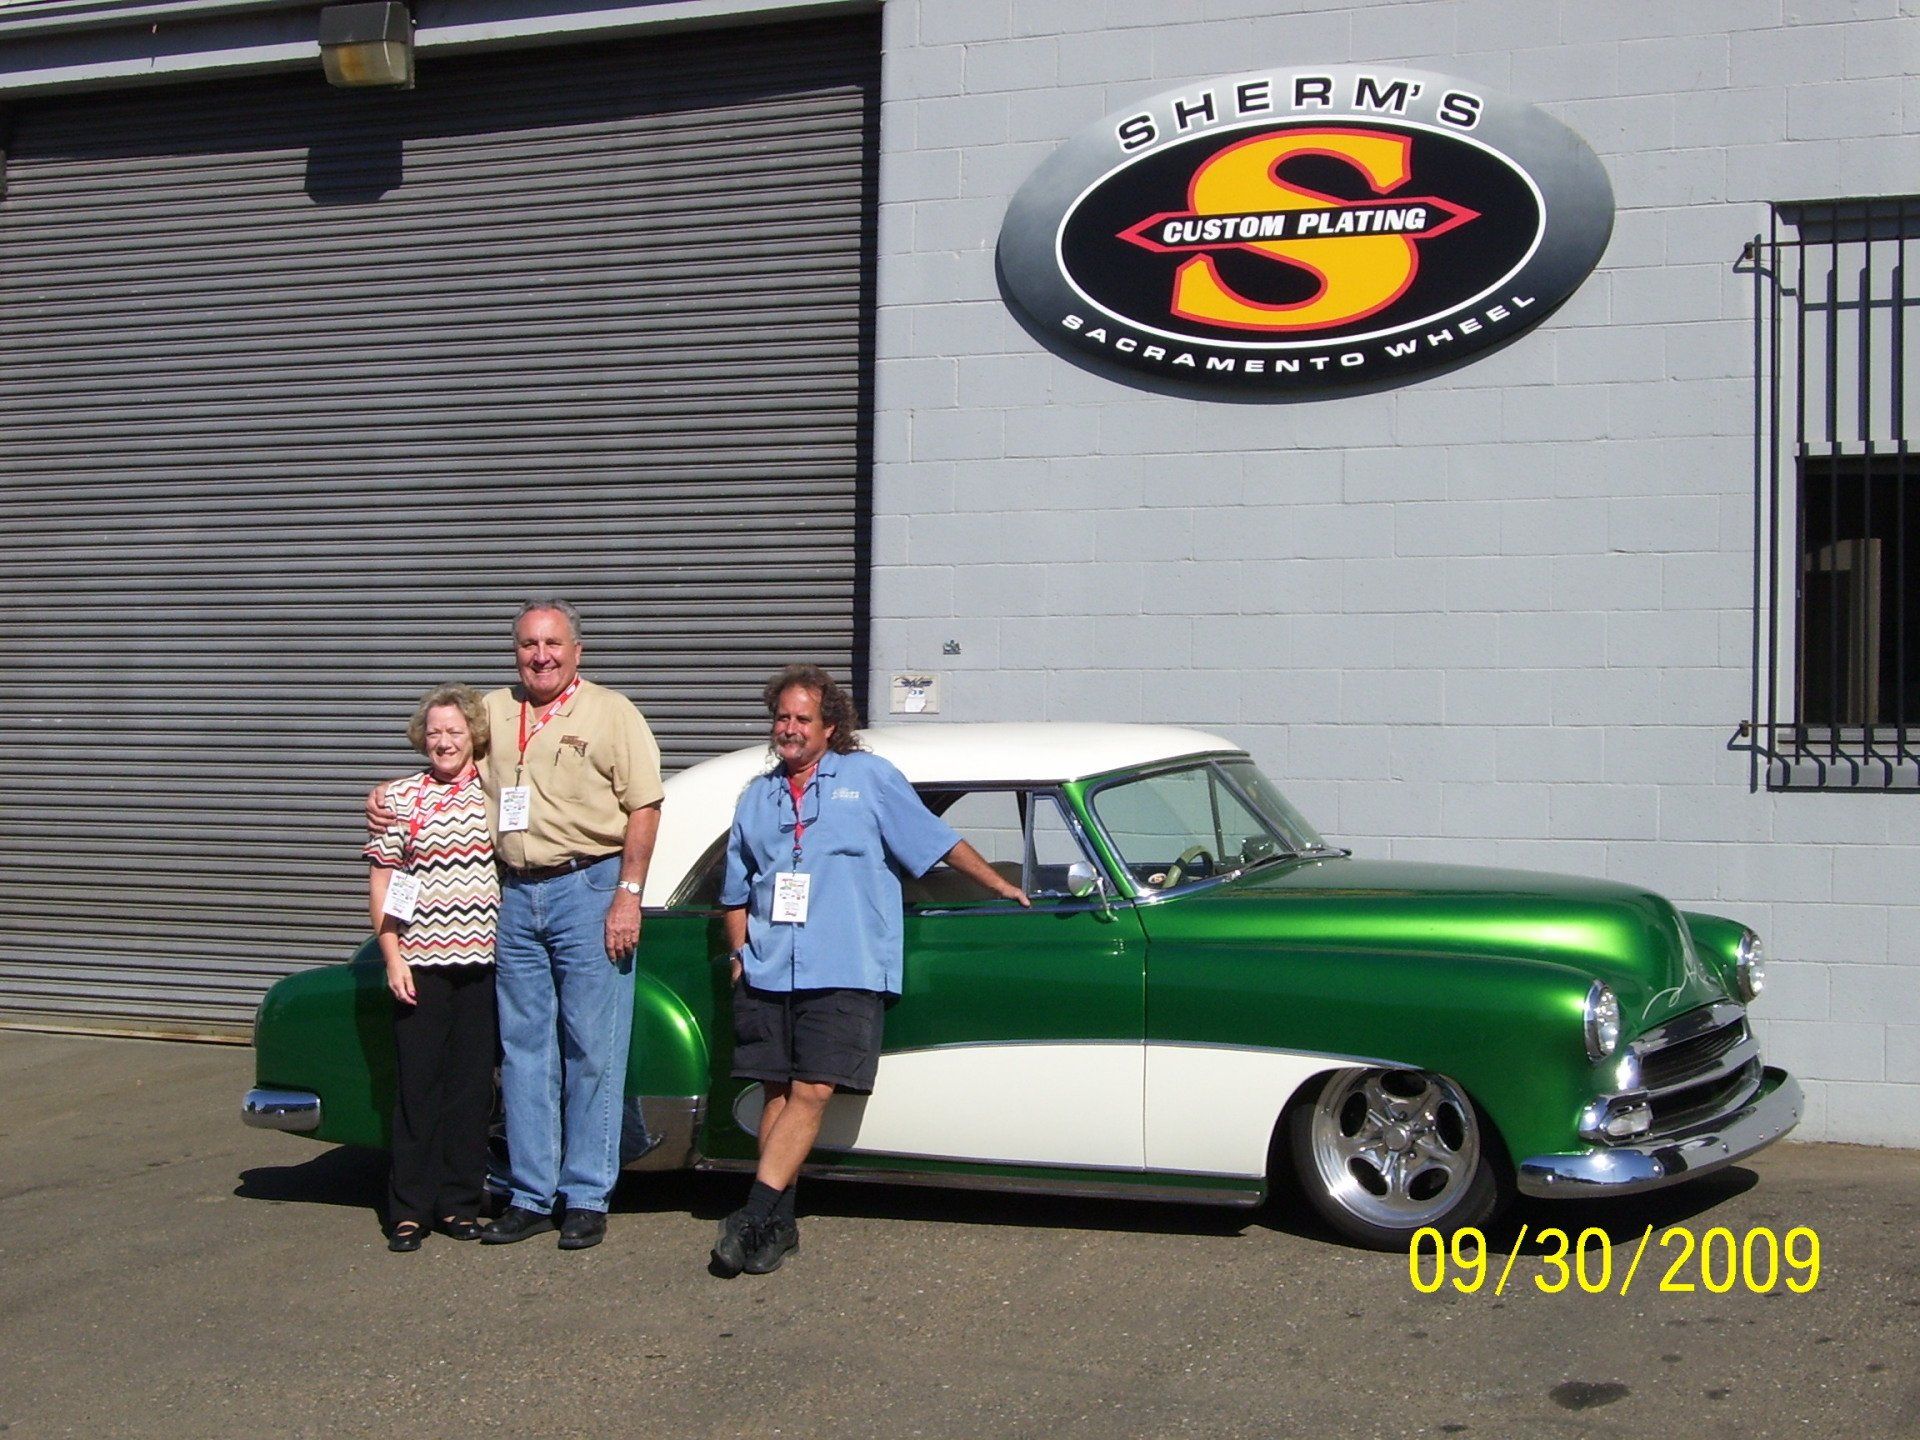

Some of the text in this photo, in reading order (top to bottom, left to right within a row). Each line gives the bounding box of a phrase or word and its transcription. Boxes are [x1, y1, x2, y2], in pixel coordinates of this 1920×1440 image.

[1117, 77, 1484, 153] SHERM'S
[1163, 208, 1427, 243] CUSTOM PLATING
[1171, 127, 1419, 332] S
[1062, 294, 1537, 372] SACRAMENTO WHEEL
